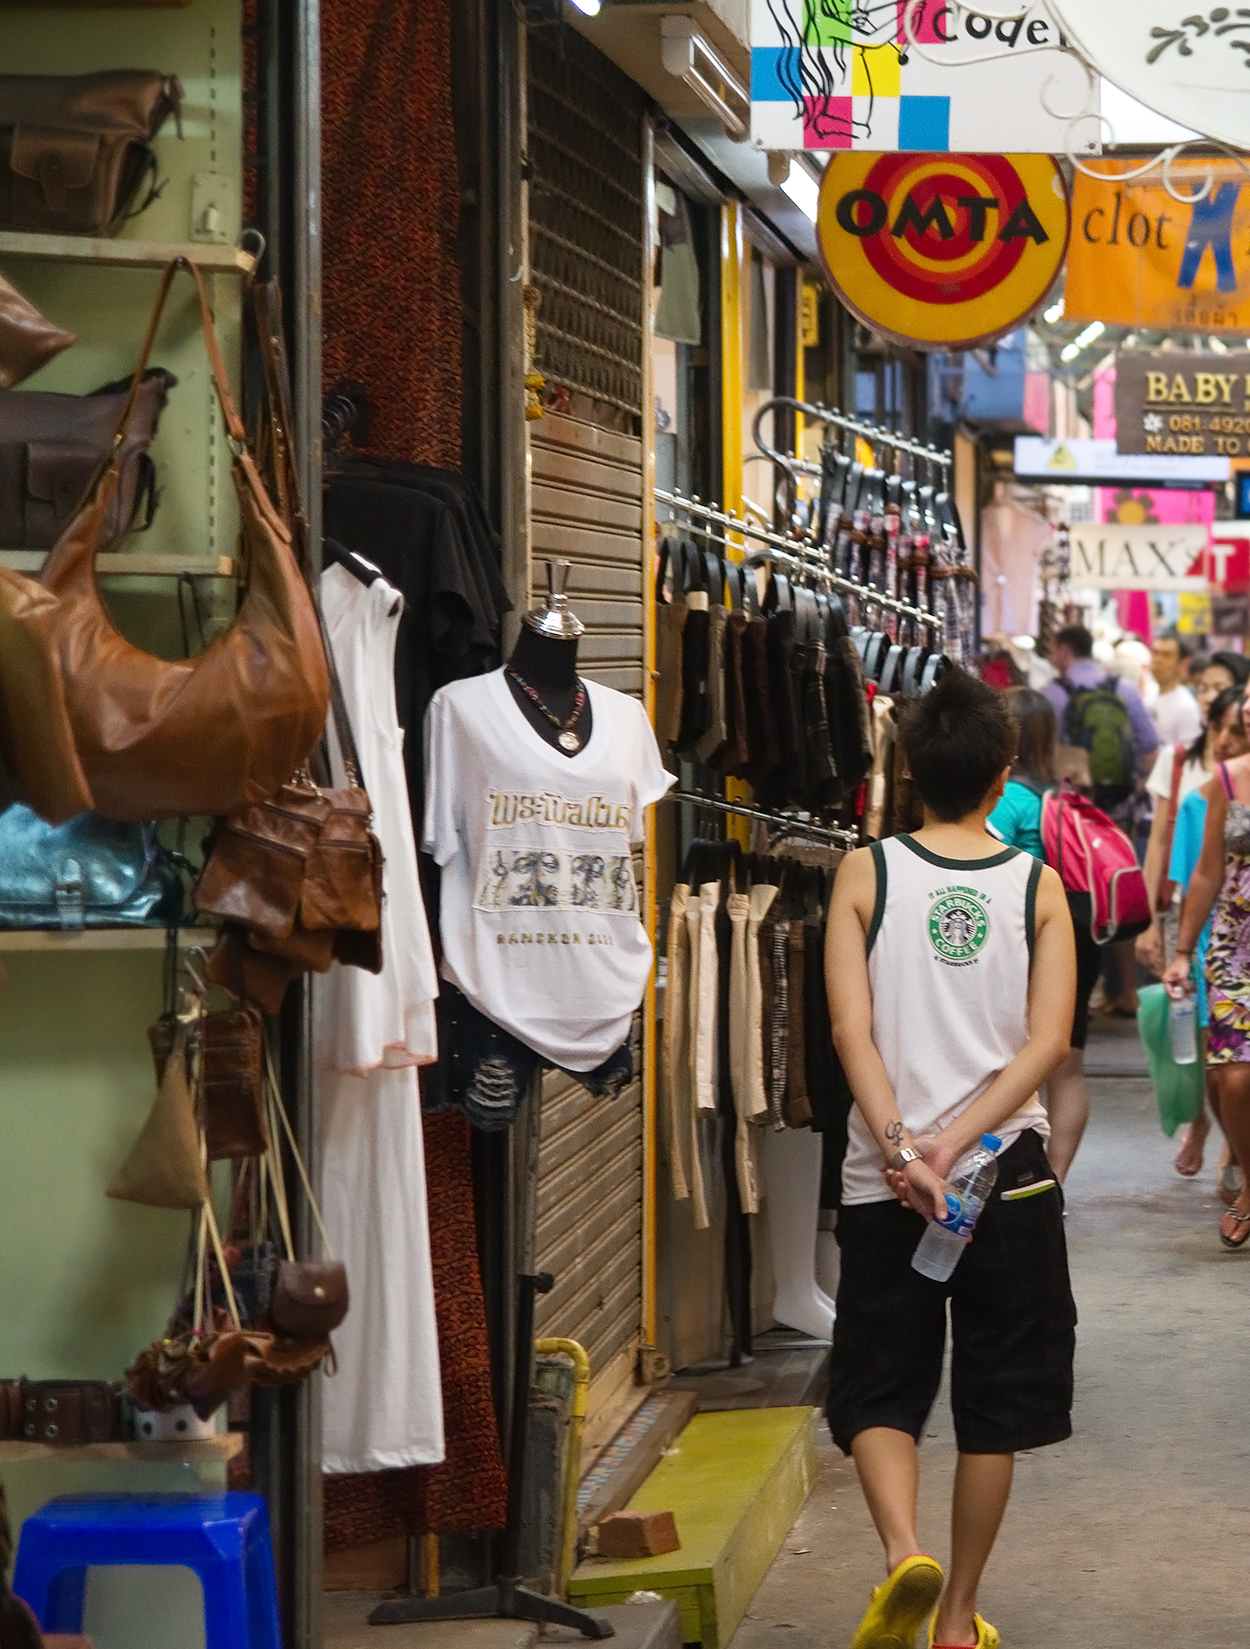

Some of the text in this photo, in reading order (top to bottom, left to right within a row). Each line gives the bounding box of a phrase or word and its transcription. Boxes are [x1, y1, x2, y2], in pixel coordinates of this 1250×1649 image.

[836, 189, 1050, 246] OMTA
[1146, 372, 1239, 403] BABY
[1146, 436, 1205, 453] MADE
[1215, 437, 1241, 454] TO
[931, 897, 986, 928] STARBUCKS
[934, 938, 978, 957] COFFEE
